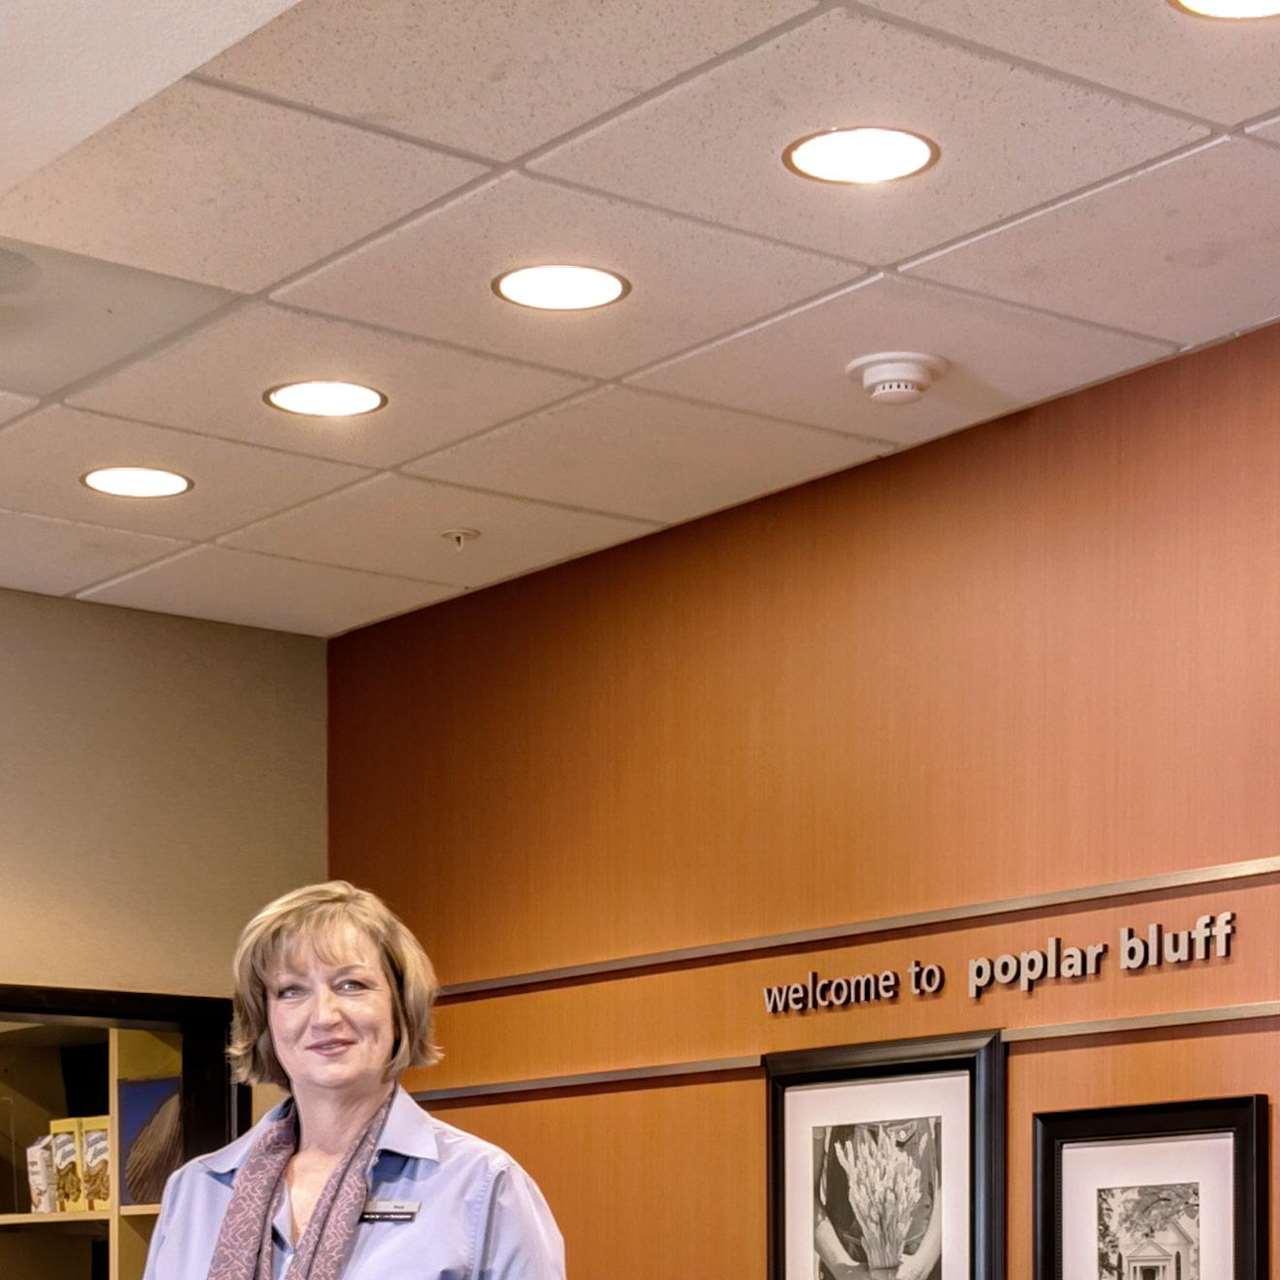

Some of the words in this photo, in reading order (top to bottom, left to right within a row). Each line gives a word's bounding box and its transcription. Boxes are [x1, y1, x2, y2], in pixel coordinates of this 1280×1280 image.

[763, 971, 897, 1014] welcome
[907, 959, 943, 994] to
[968, 937, 1107, 998] poplar
[1120, 911, 1237, 970] bluff
